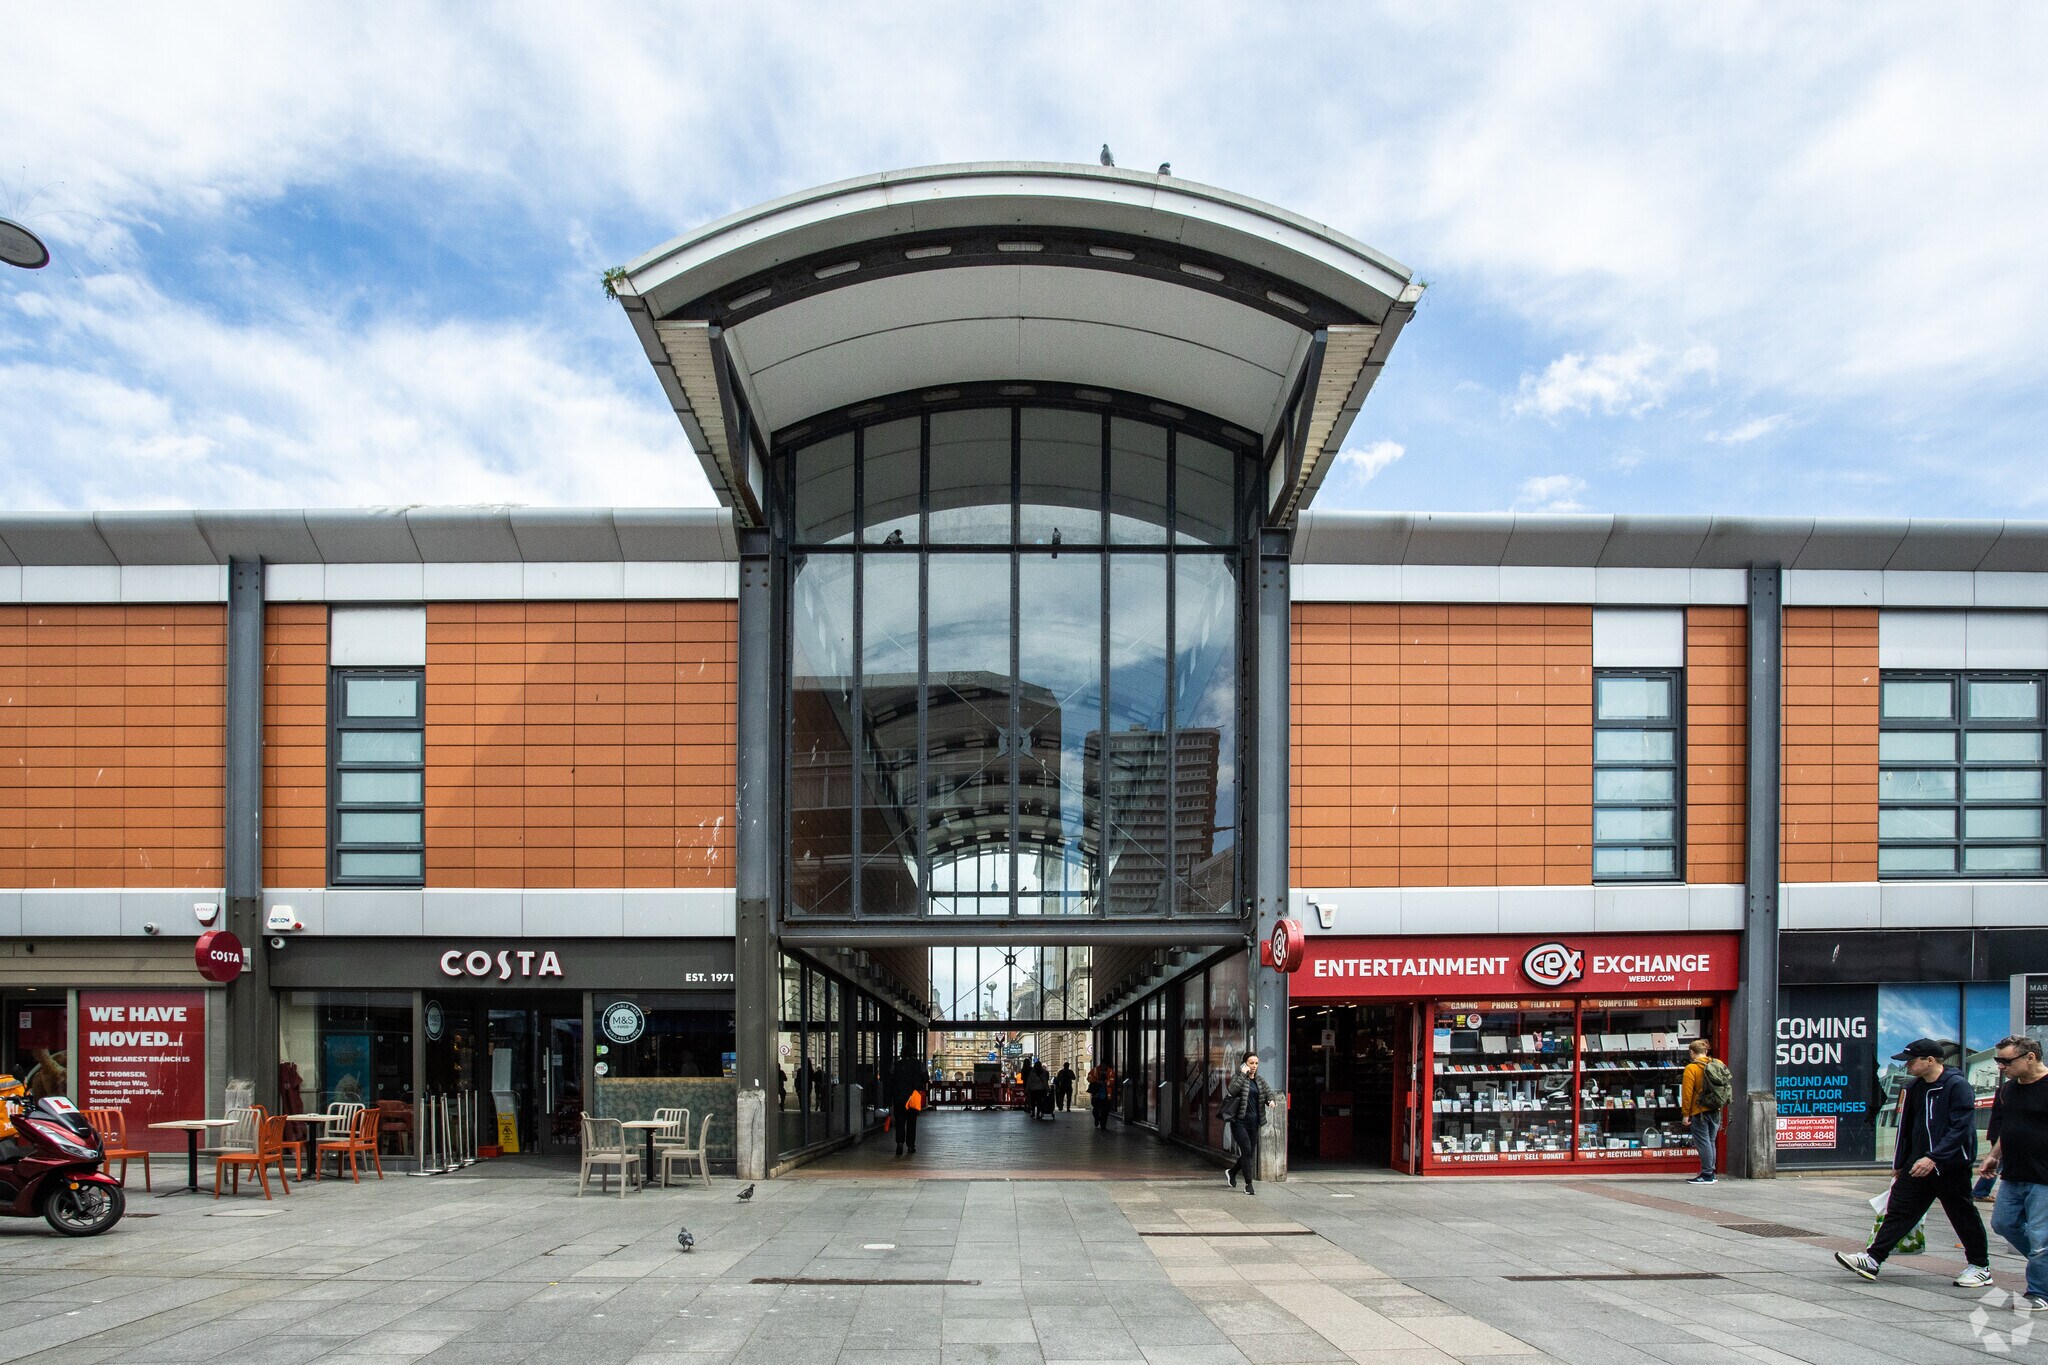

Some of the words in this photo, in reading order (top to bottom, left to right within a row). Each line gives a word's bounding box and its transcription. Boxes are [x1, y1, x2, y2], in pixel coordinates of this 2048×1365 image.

[210, 950, 240, 963] COSTA
[440, 950, 563, 980] COSTA
[1314, 957, 1510, 977] ENTERTAINMENT
[1592, 954, 1710, 974] EXCHANGE
[685, 973, 708, 982] EST.
[710, 973, 734, 982] 1971
[1628, 975, 1675, 983] WEBUY.COM
[1450, 1001, 1478, 1010] GAMING
[1491, 1001, 1518, 1010] PHONES
[1530, 1000, 1545, 1009] FILM
[1552, 1000, 1561, 1008] TV
[1598, 1000, 1638, 1008] COMPUTING
[1658, 998, 1702, 1006] ELECTRONICS
[89, 1007, 125, 1022] WE
[129, 1007, 187, 1022] HAVE
[612, 1016, 634, 1025] M&S
[1776, 1017, 1867, 1039] COMING
[1776, 1043, 1842, 1065] SOON
[1776, 1076, 1822, 1087] GROUND
[1823, 1075, 1848, 1086] AND
[145, 1088, 164, 1096] Park,
[1776, 1089, 1804, 1100] FIRST
[1806, 1089, 1842, 1099] FLOOR
[53, 1099, 72, 1109] L
[1776, 1103, 1811, 1114] RETAIL
[1812, 1101, 1866, 1112] PREMISES
[1788, 1118, 1834, 1126] barkerproudlove
[1776, 1132, 1793, 1140] 0113
[1795, 1132, 1811, 1140] 388
[1813, 1131, 1834, 1140] 4848
[1463, 1154, 1498, 1162] RECYCLING
[1607, 1150, 1642, 1158] RECYCLING
